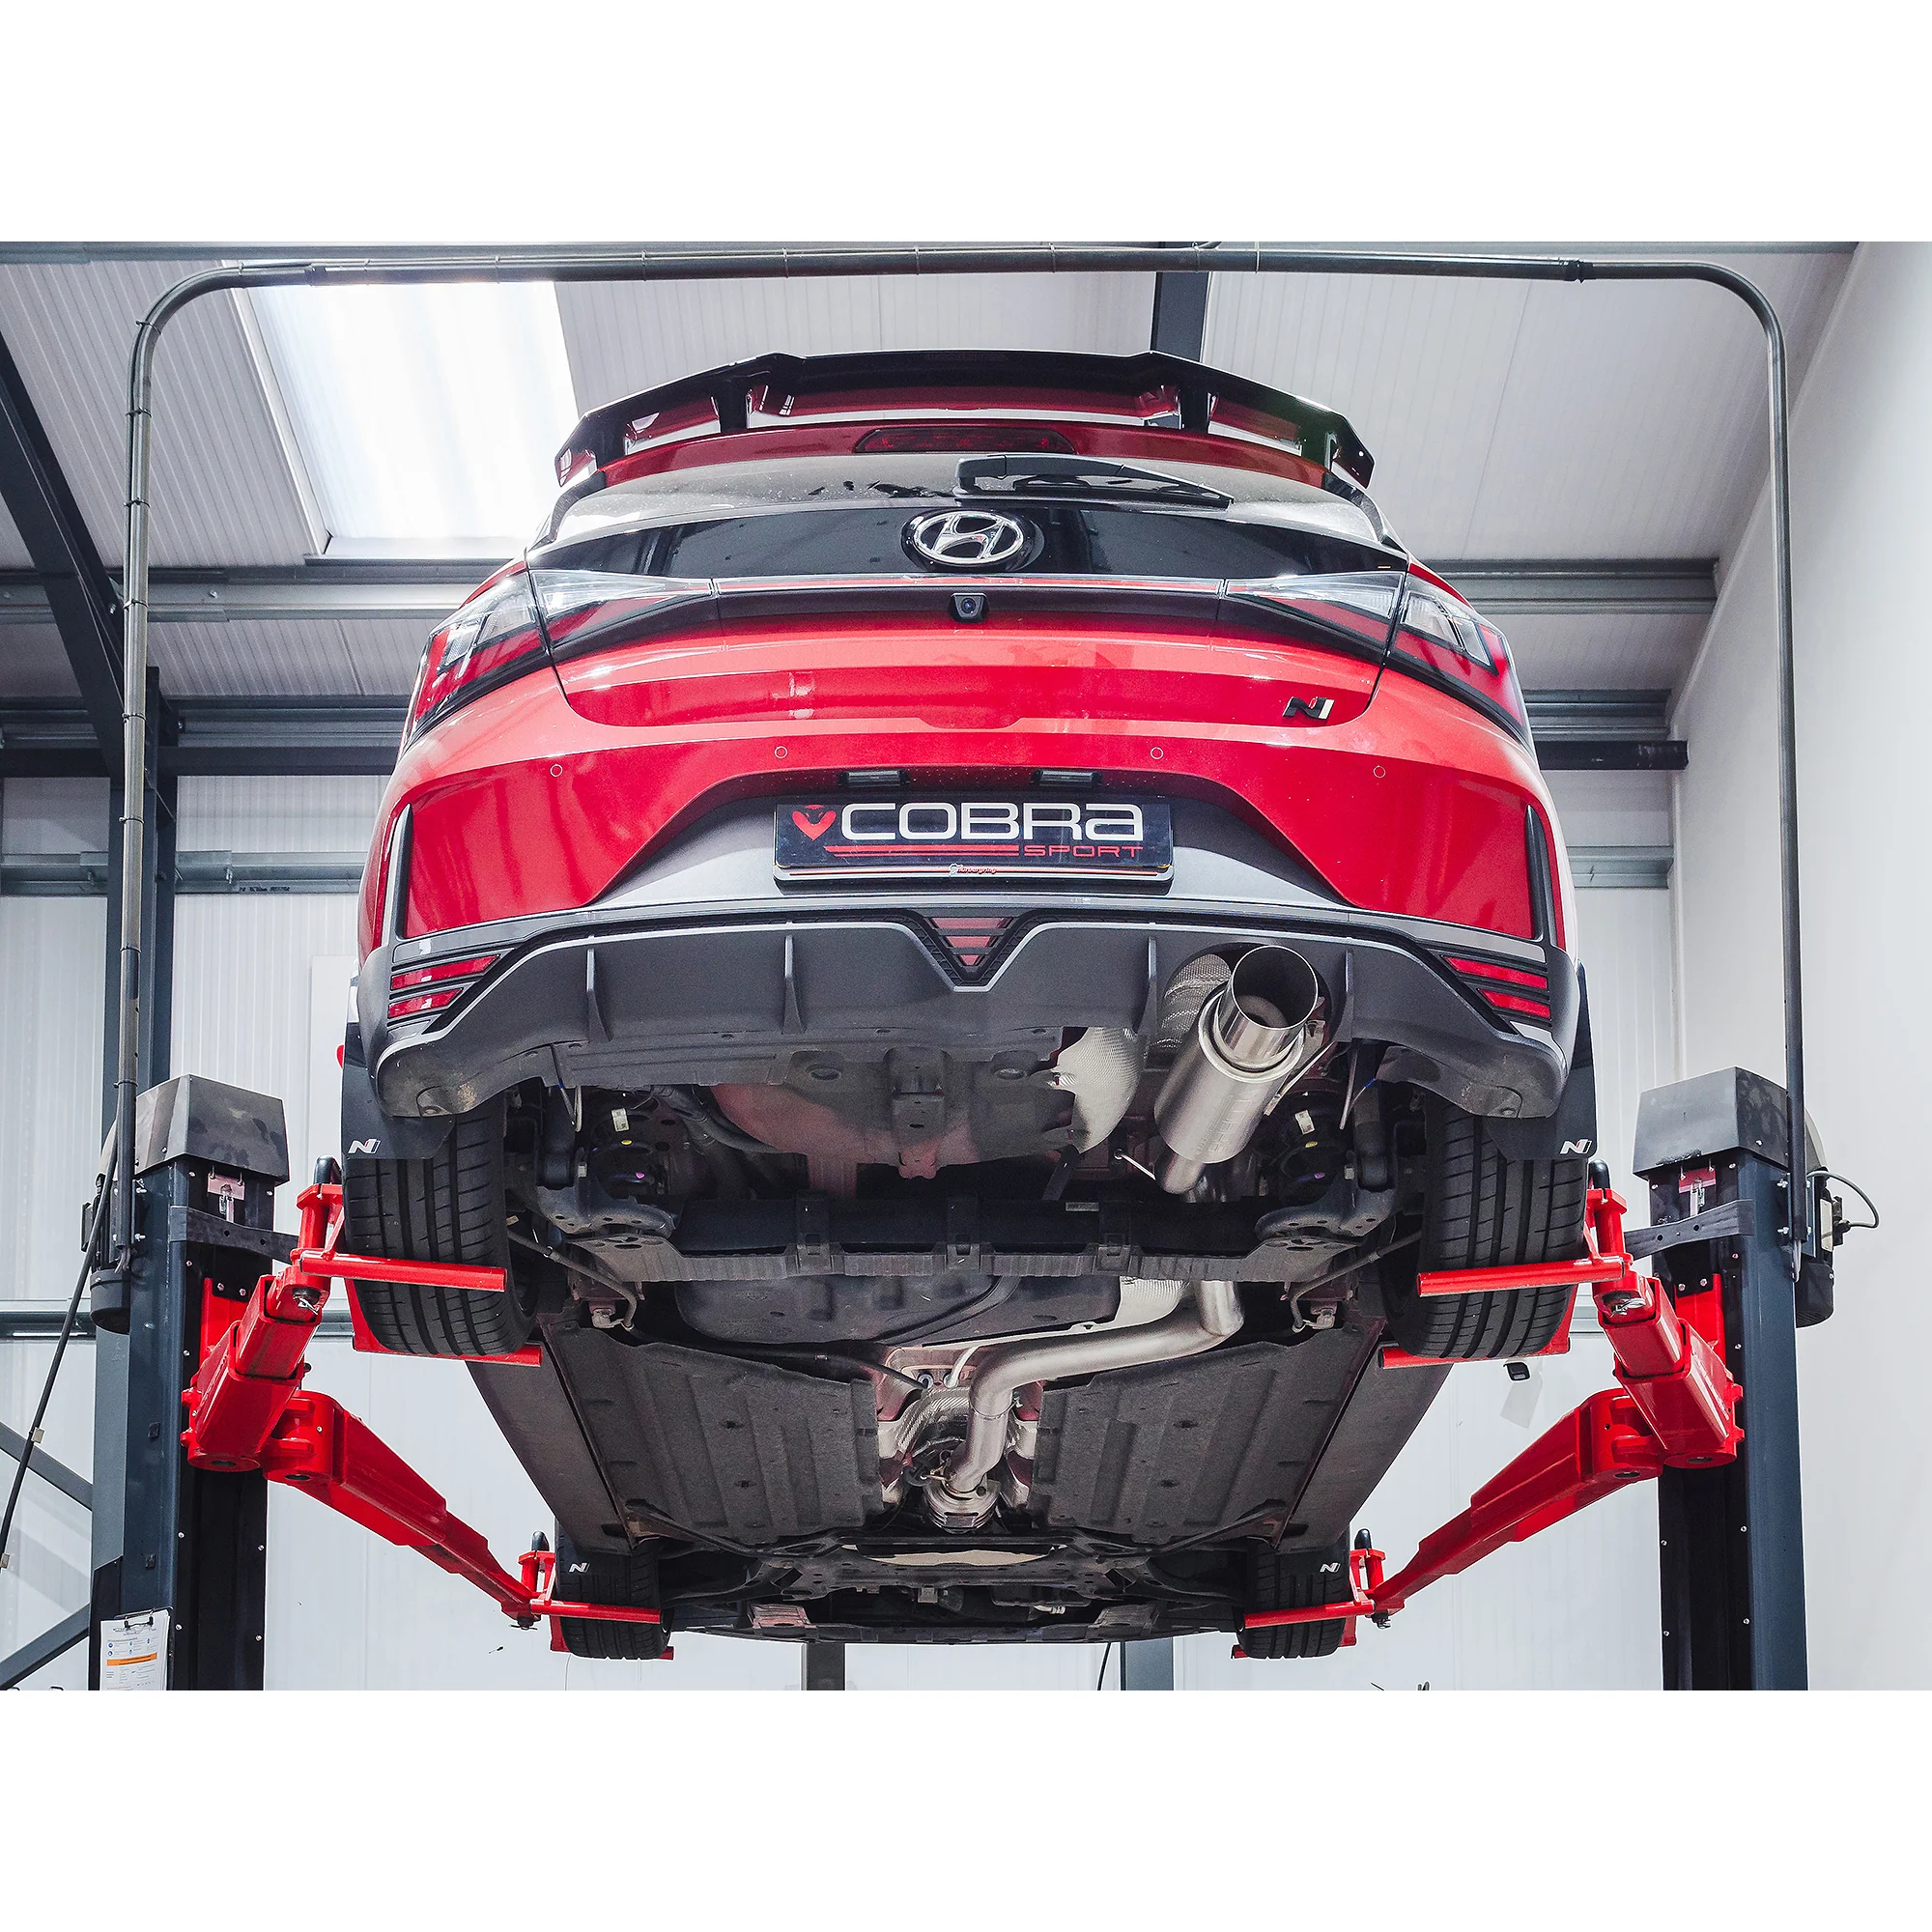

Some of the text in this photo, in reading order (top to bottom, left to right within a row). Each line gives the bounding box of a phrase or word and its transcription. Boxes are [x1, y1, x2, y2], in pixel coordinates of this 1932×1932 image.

[1283, 696, 1335, 720] N
[1024, 845, 1144, 858] SPORT
[348, 1138, 382, 1153] N
[1559, 1138, 1592, 1153] N
